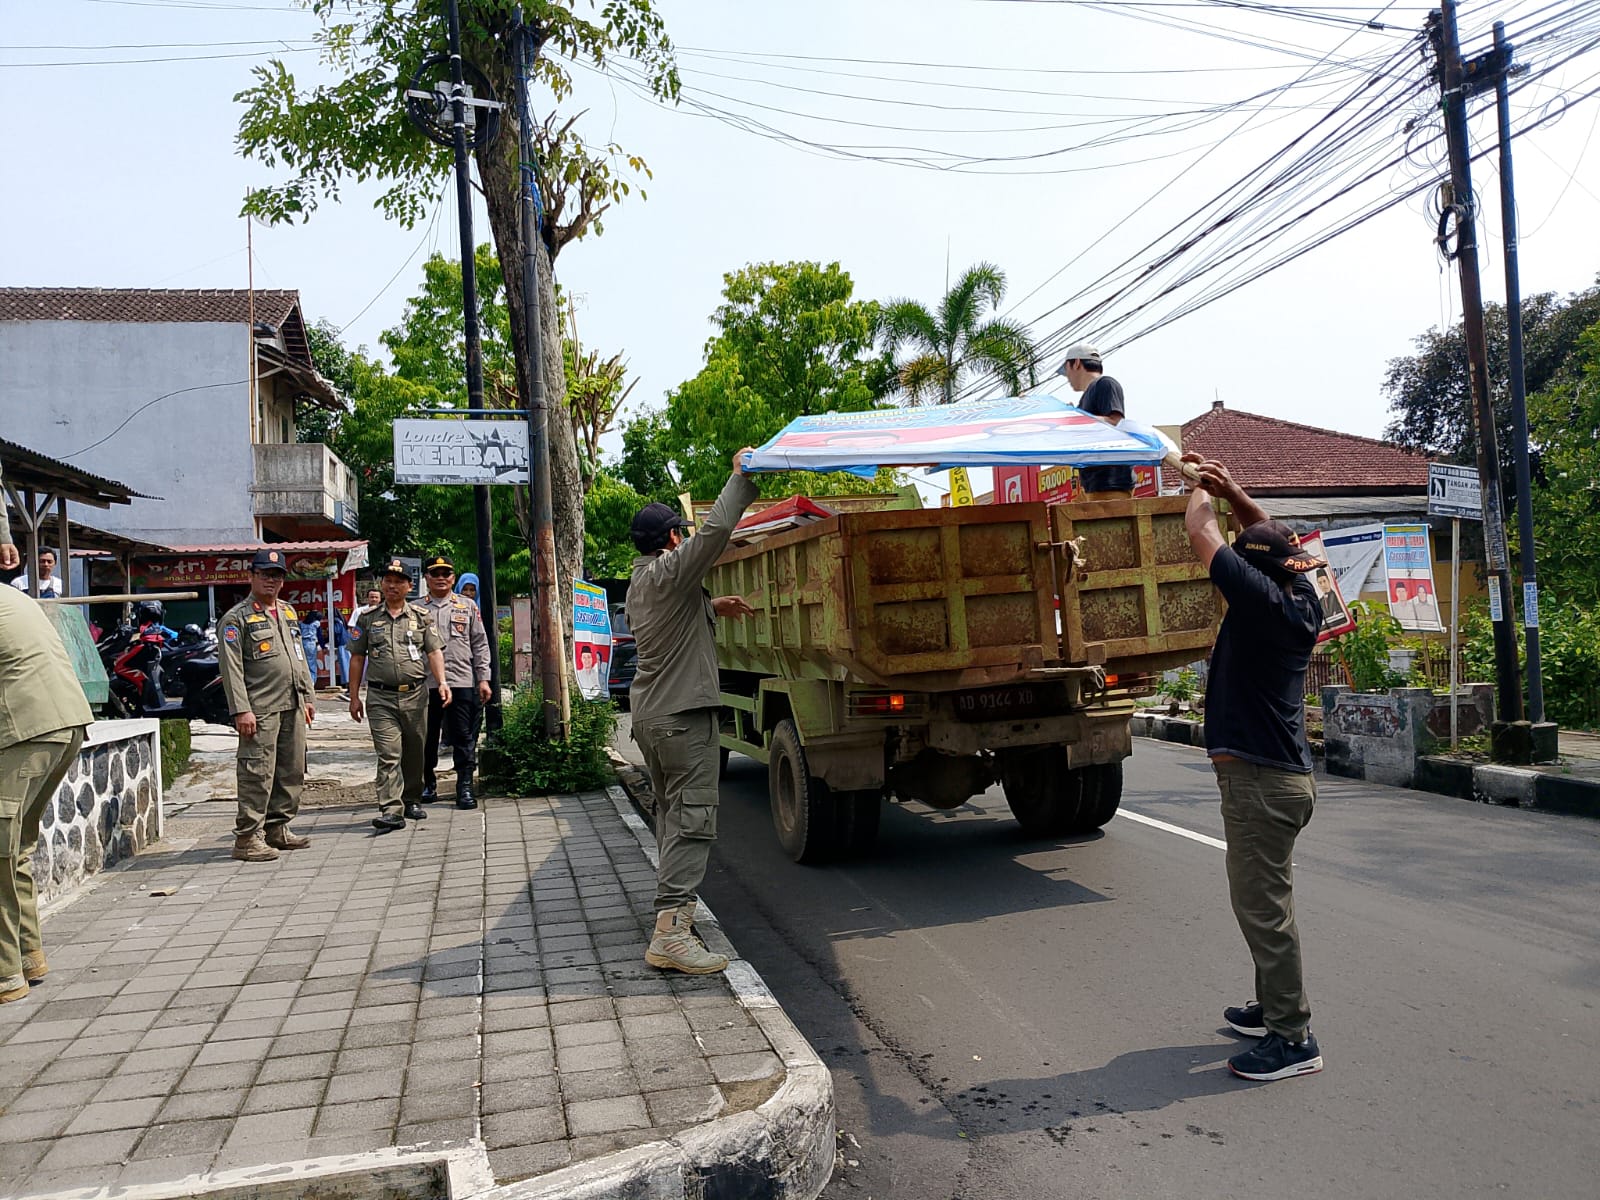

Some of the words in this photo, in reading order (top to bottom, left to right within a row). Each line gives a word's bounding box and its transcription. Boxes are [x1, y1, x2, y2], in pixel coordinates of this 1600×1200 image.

[402, 444, 527, 466] KEMBAR
[215, 558, 252, 571] Zah
[960, 694, 975, 710] AD
